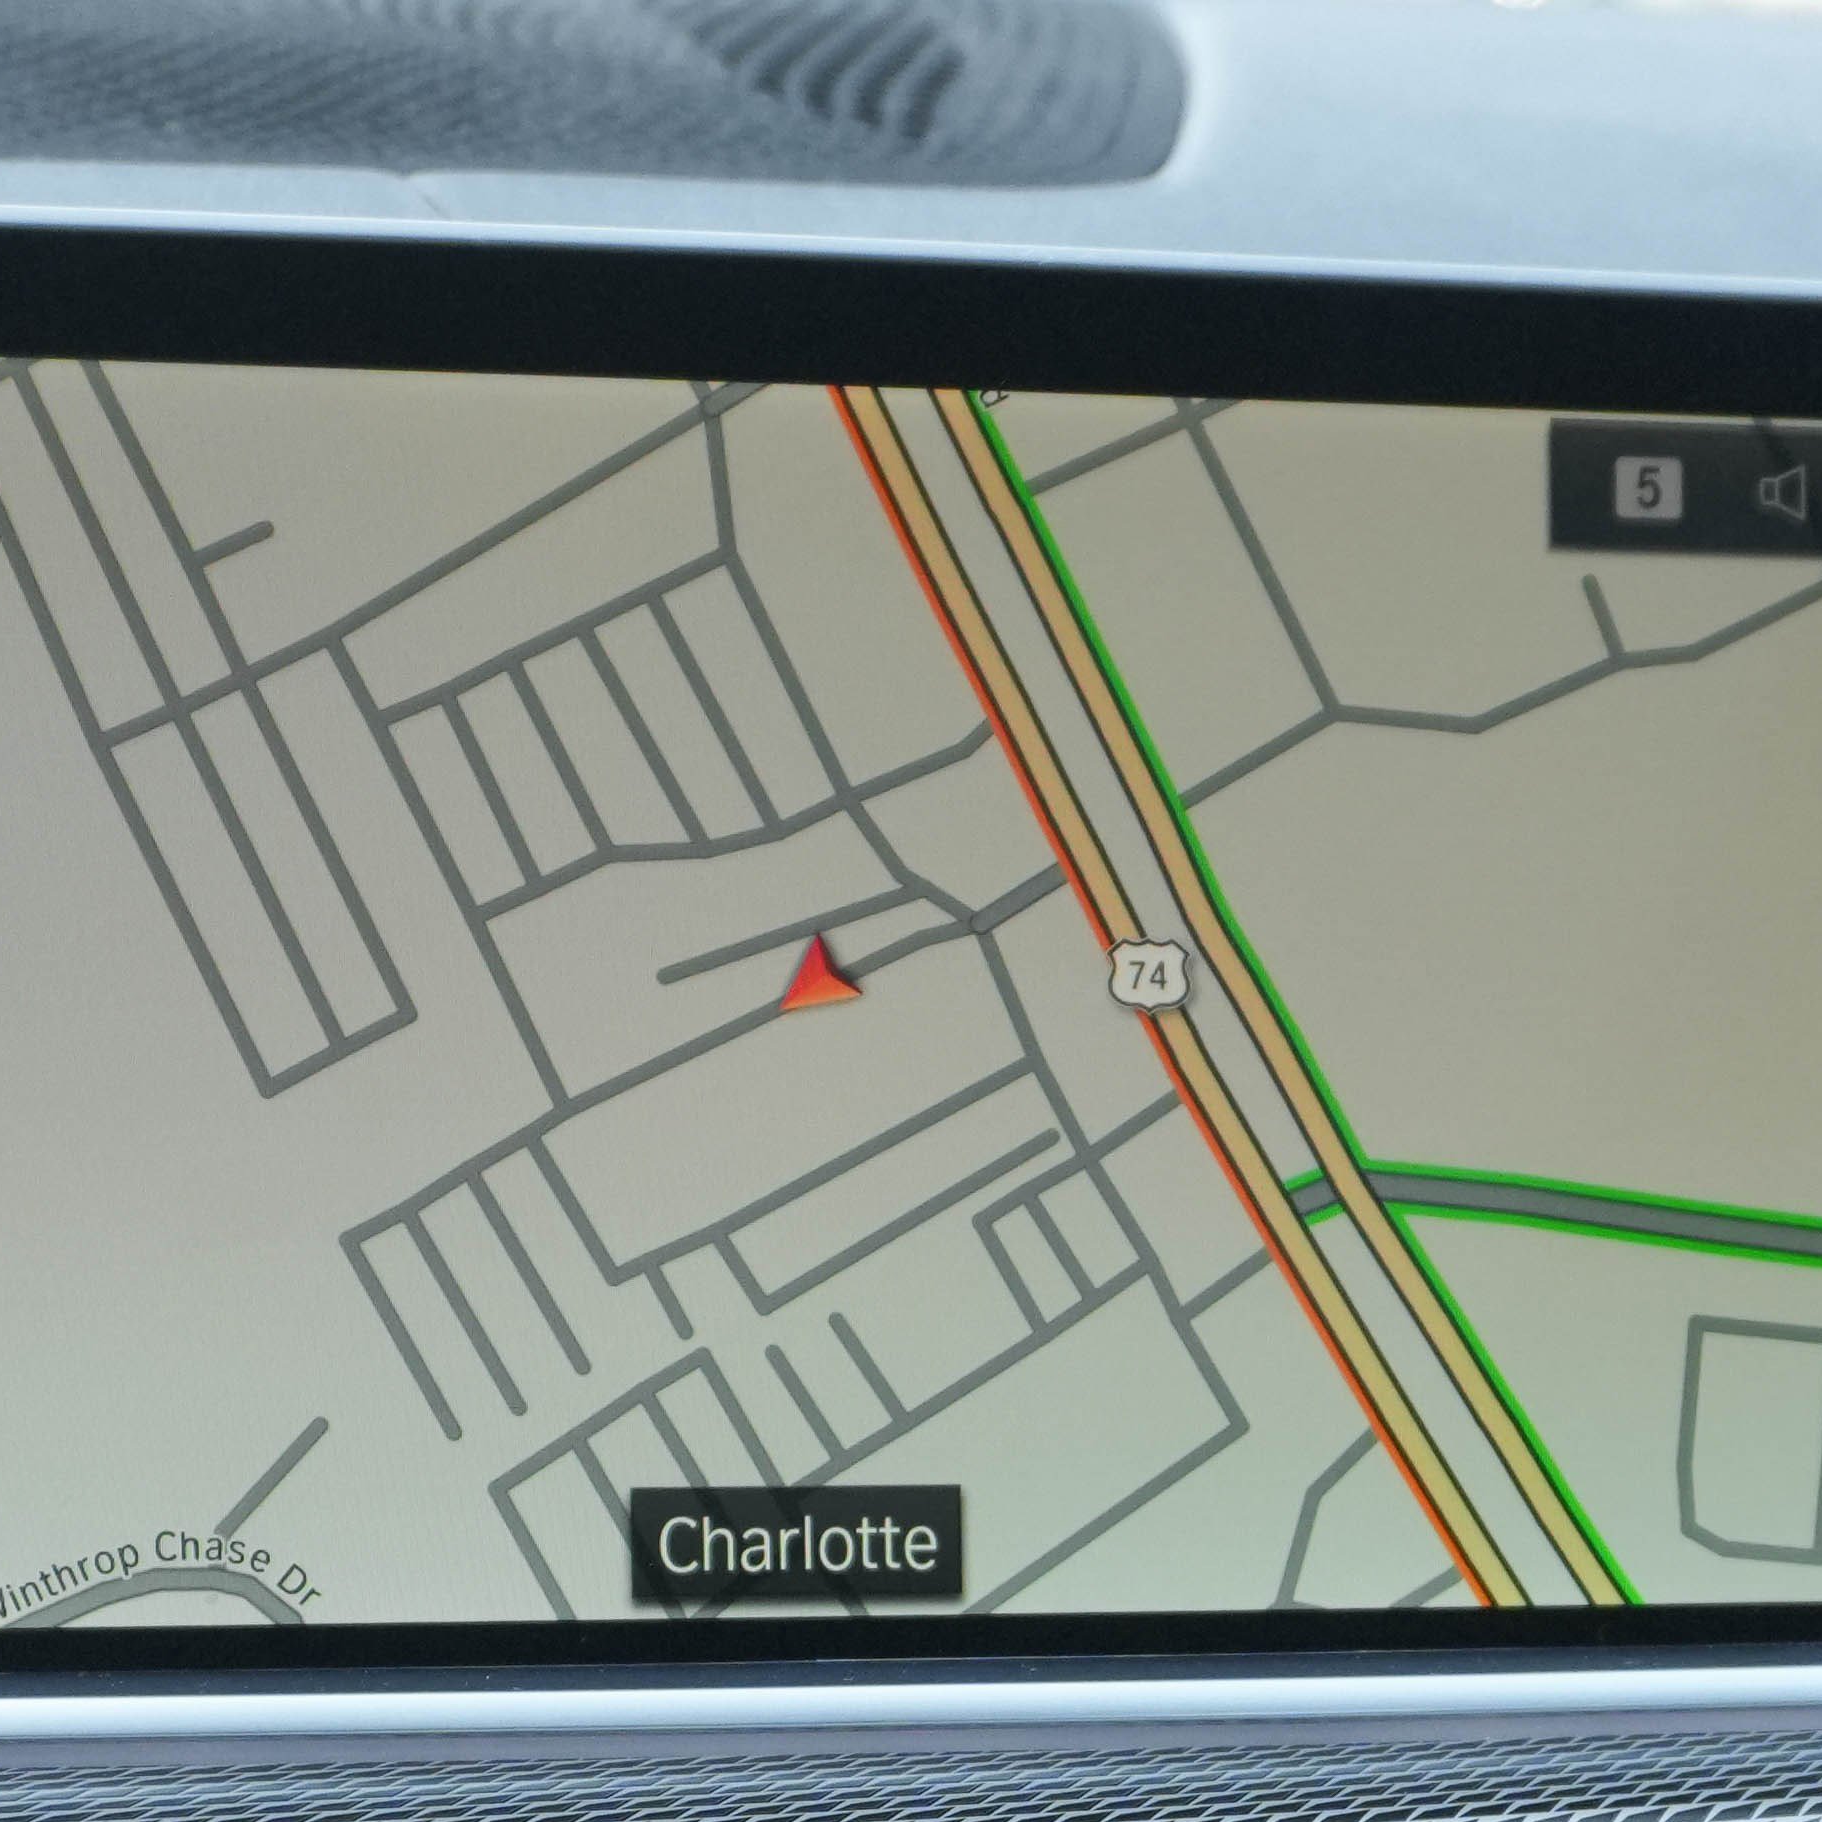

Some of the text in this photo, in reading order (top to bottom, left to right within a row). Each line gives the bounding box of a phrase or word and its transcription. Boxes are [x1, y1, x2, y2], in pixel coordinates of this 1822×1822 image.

[1637, 467, 1661, 510] 5
[1129, 960, 1168, 990] 74
[155, 1530, 271, 1572] Chase
[277, 1563, 322, 1606] Dr
[658, 1514, 939, 1575] Charlotte
